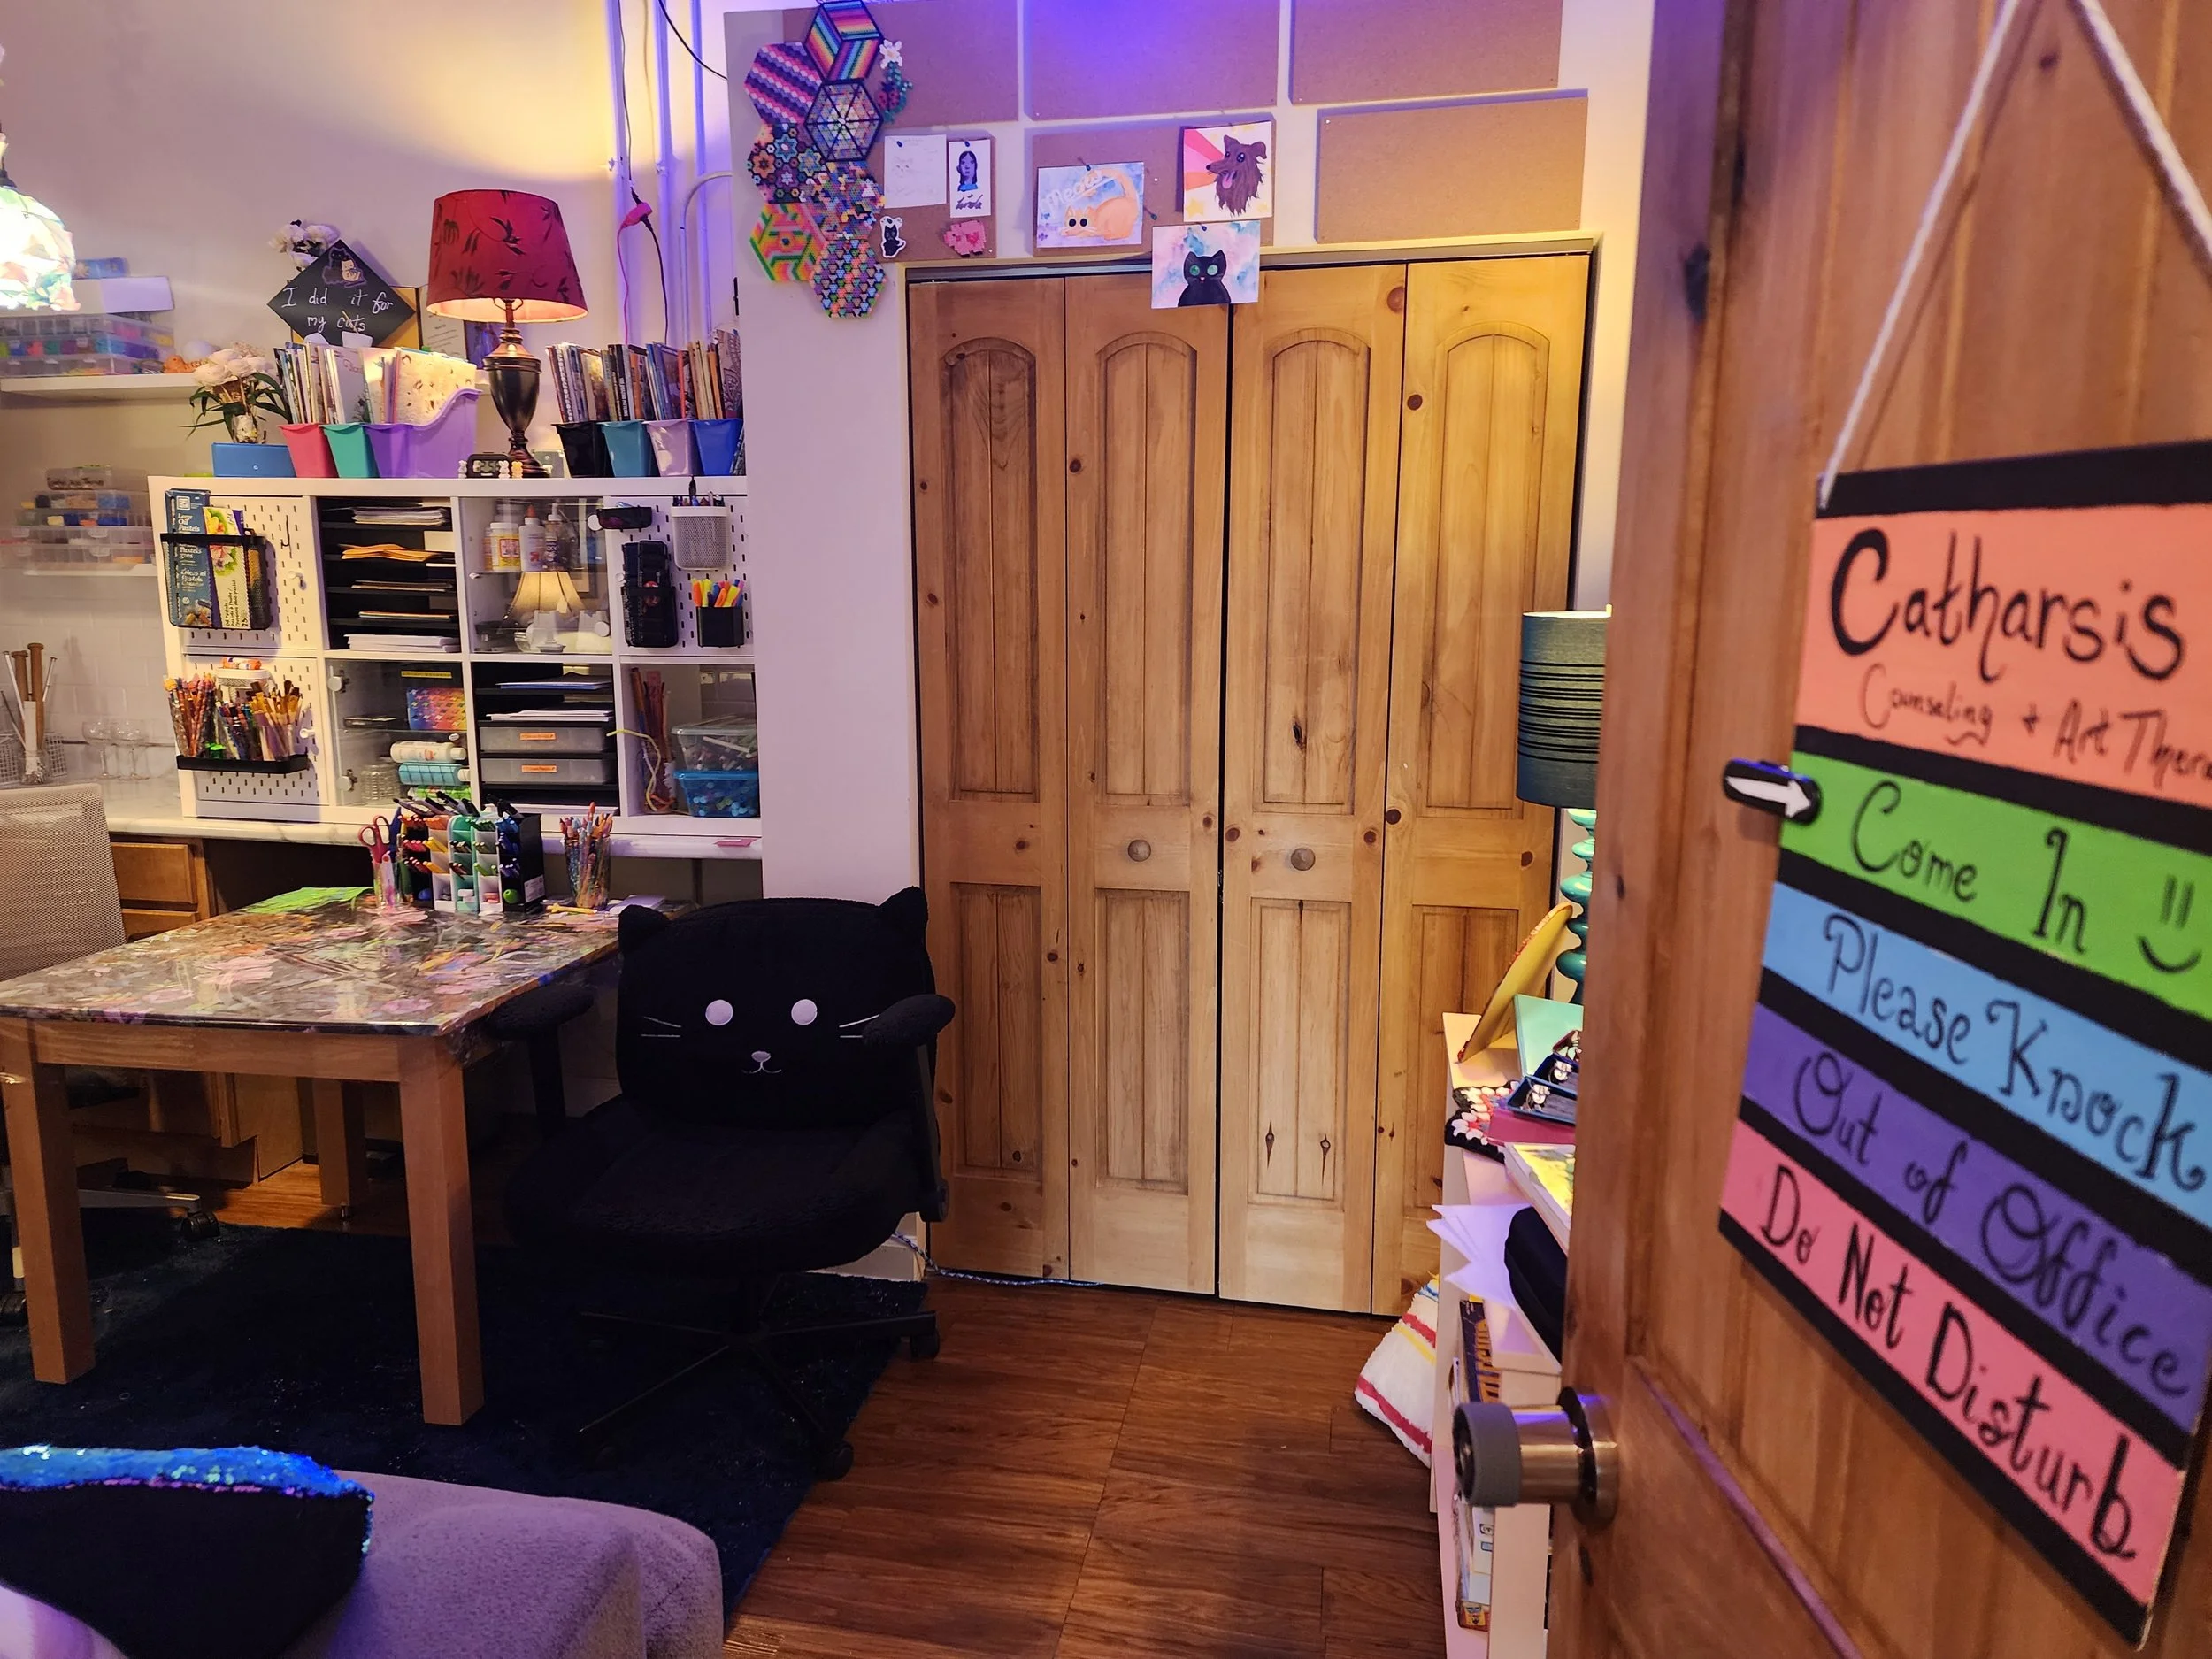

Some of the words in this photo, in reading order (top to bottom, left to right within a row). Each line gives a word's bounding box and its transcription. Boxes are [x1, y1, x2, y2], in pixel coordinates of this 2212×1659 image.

[281, 287, 298, 307] I
[309, 288, 327, 306] did
[350, 289, 368, 306] it
[372, 291, 394, 313] for
[308, 316, 326, 333] my
[337, 314, 365, 332] cats
[242, 618, 248, 627] 25
[1831, 527, 2184, 683] Catharsis
[1862, 663, 1993, 748] Counseling
[2022, 704, 2040, 736] +
[2053, 698, 2113, 764] Art
[1852, 780, 1978, 902] Come
[2032, 827, 2087, 954] In
[1824, 912, 1971, 1065] Please
[1985, 999, 2206, 1192] Knock
[1794, 1052, 1884, 1165] Out
[1904, 1141, 1969, 1225] of
[1981, 1183, 2191, 1399] Office
[1760, 1164, 1819, 1264] Do
[1839, 1222, 1913, 1349] Not
[1926, 1302, 2138, 1560] Disturb
